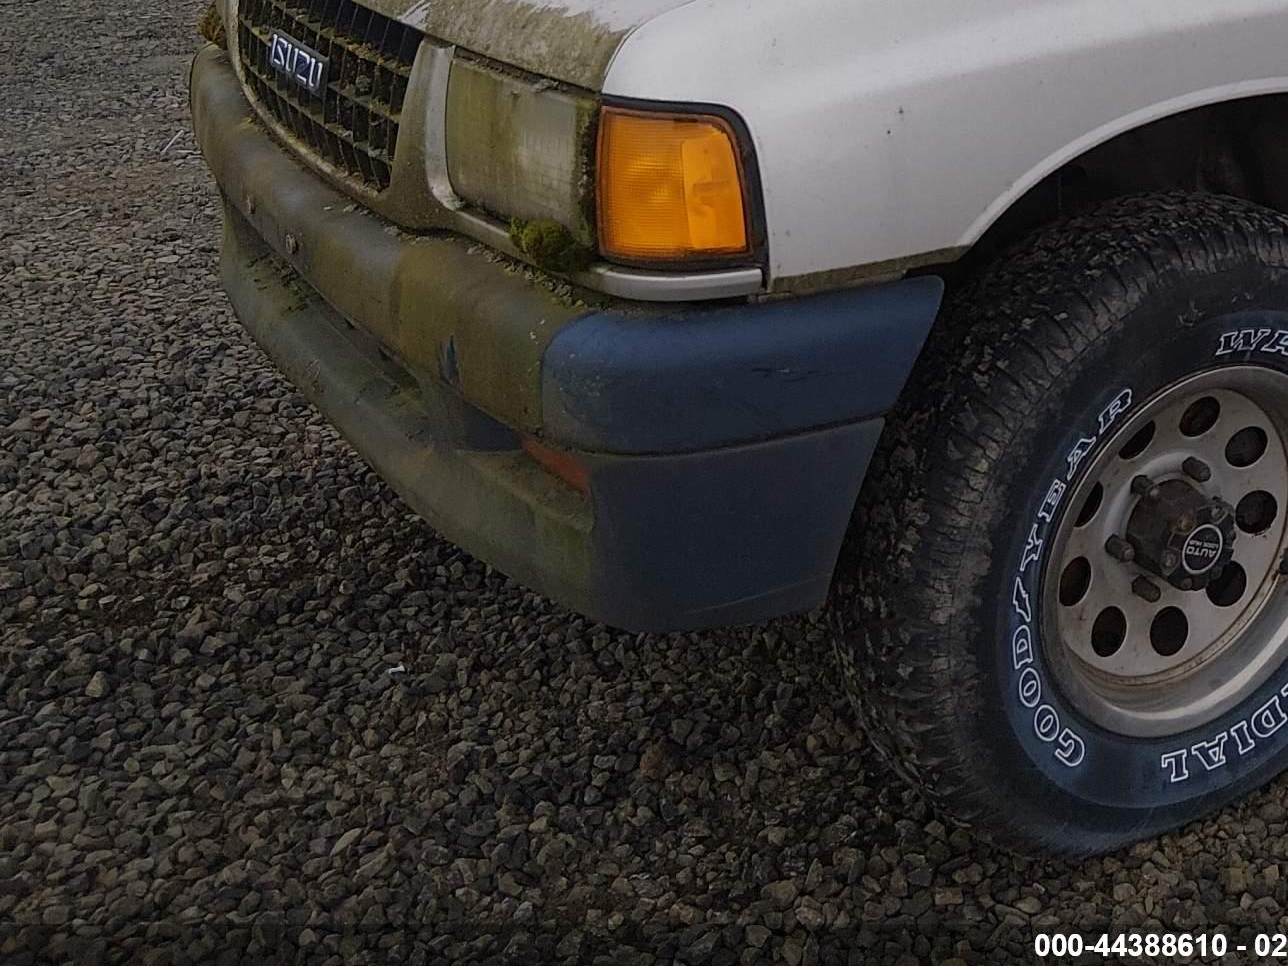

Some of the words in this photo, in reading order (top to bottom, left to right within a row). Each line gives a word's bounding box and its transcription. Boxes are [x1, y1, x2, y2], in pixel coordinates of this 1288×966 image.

[270, 33, 324, 88] ISUZU
[1012, 387, 1135, 768] GOODYEAR
[1186, 545, 1218, 558] AUTO
